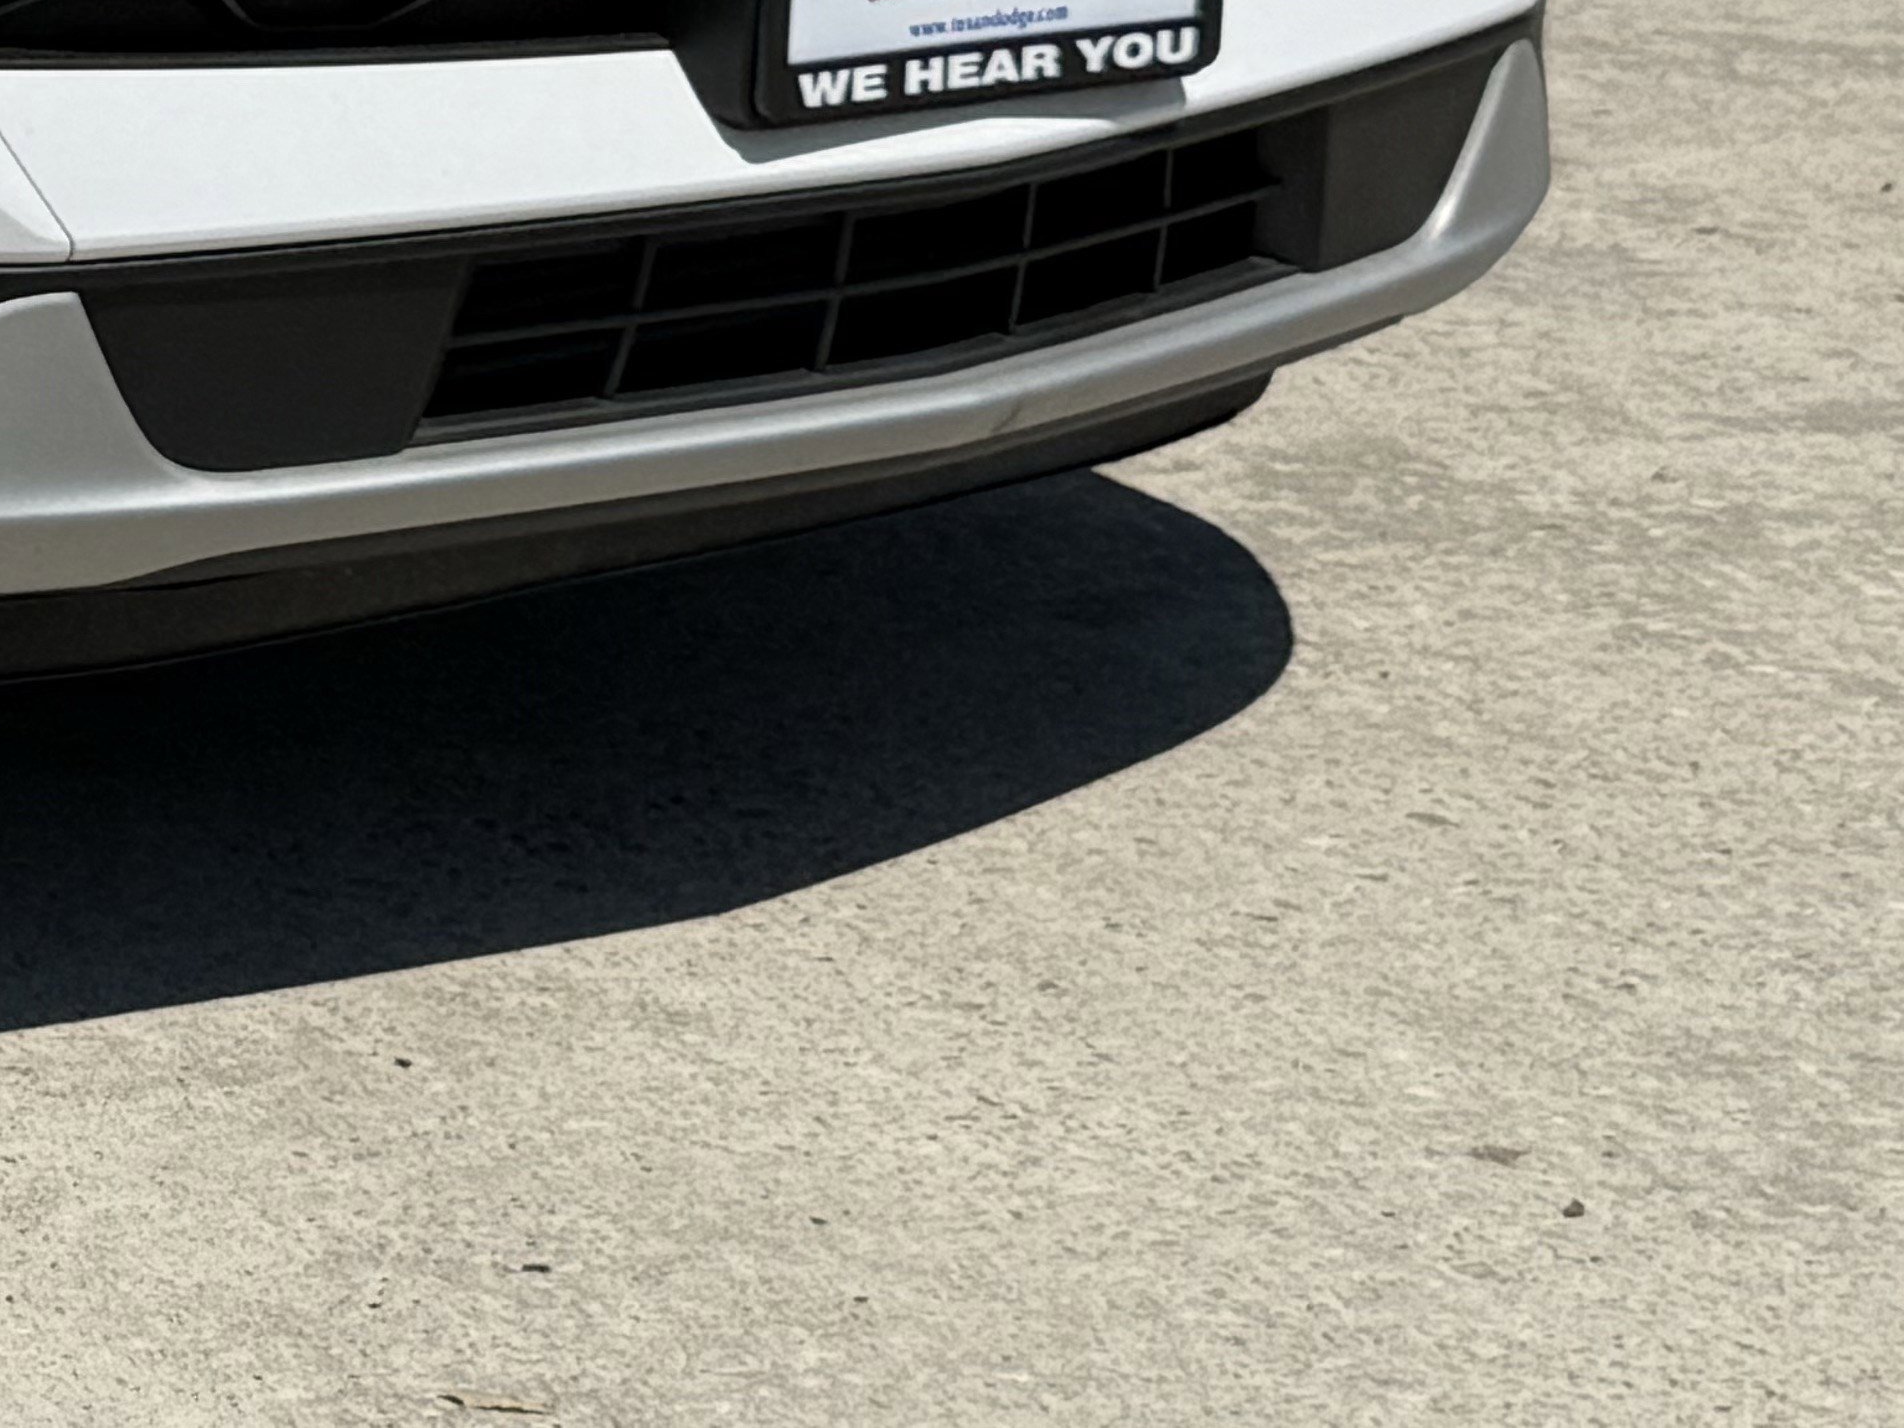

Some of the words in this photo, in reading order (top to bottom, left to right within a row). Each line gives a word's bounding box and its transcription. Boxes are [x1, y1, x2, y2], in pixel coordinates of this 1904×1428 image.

[799, 64, 887, 109] WE
[904, 42, 1060, 96] HEAR
[1075, 26, 1200, 73] YOU
